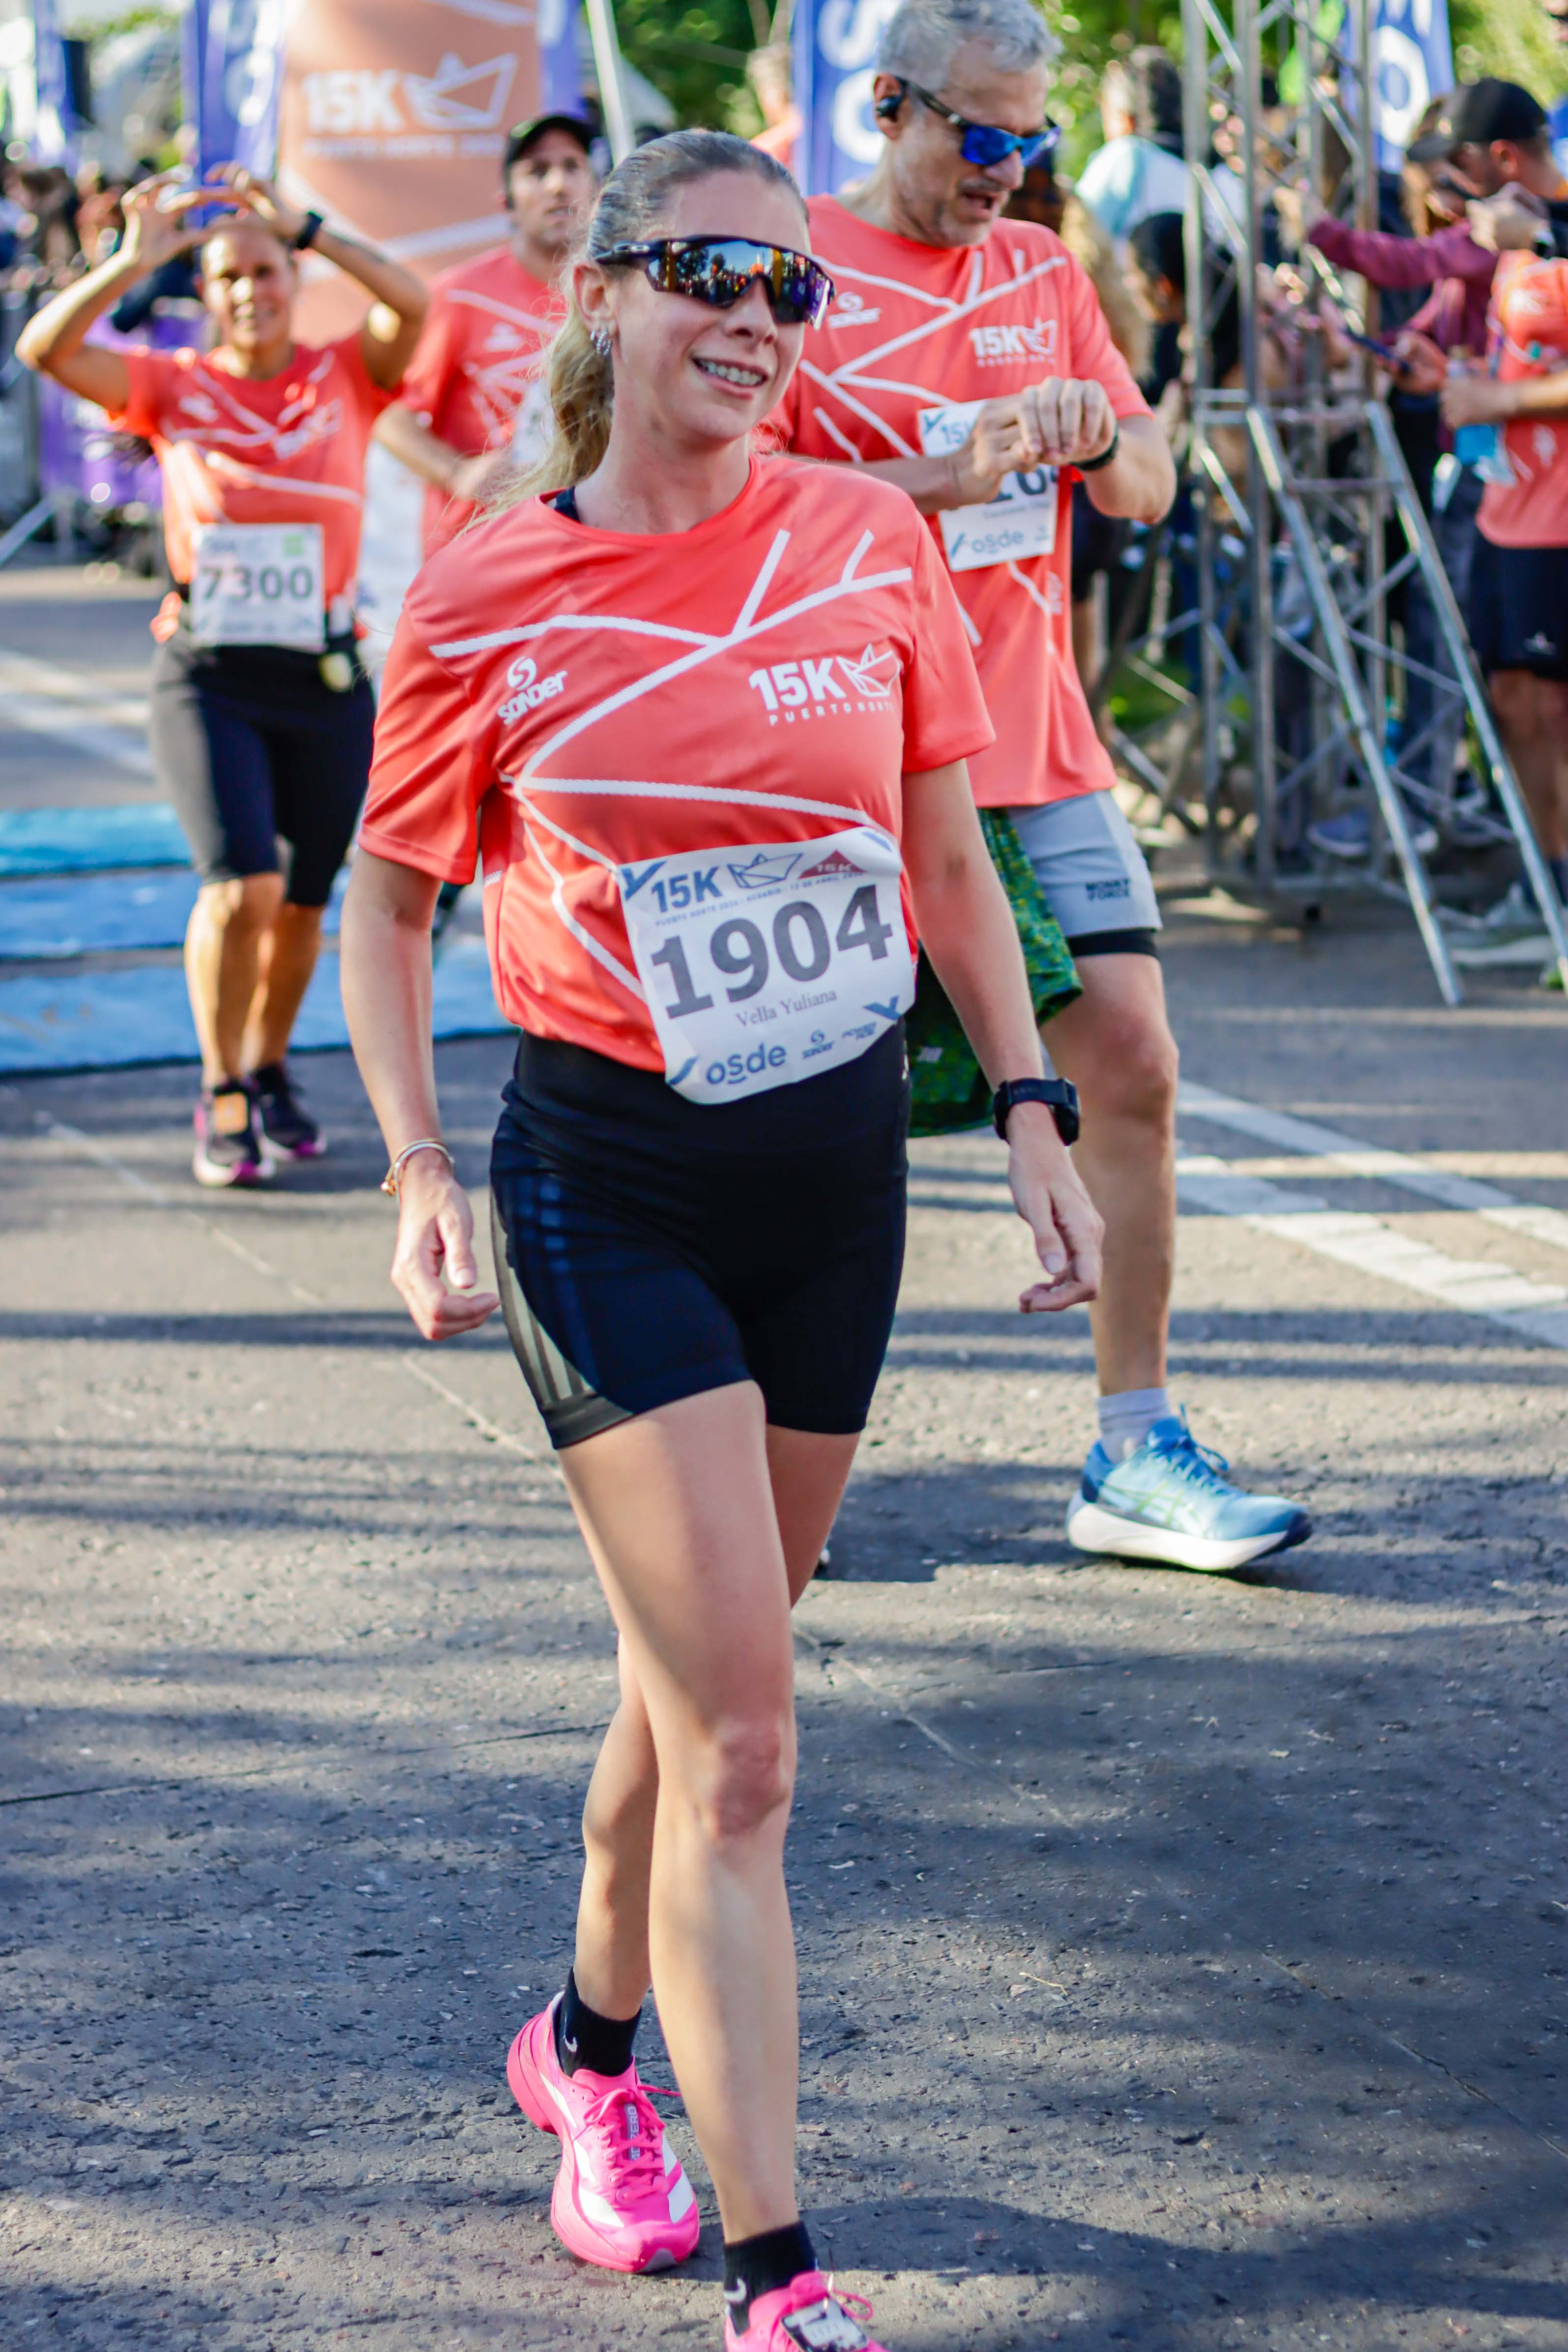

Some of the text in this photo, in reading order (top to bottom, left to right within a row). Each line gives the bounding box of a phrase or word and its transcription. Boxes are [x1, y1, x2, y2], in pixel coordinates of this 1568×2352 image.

[302, 69, 403, 133] 15K
[969, 324, 1027, 358] 15K
[201, 565, 313, 601] 7300
[748, 657, 846, 711] 15K
[769, 702, 852, 727] PUERTO
[651, 865, 723, 913] 15K
[651, 883, 893, 1020] 1904
[736, 989, 837, 1026] Vella Yuliana
[706, 1041, 787, 1085] osde
